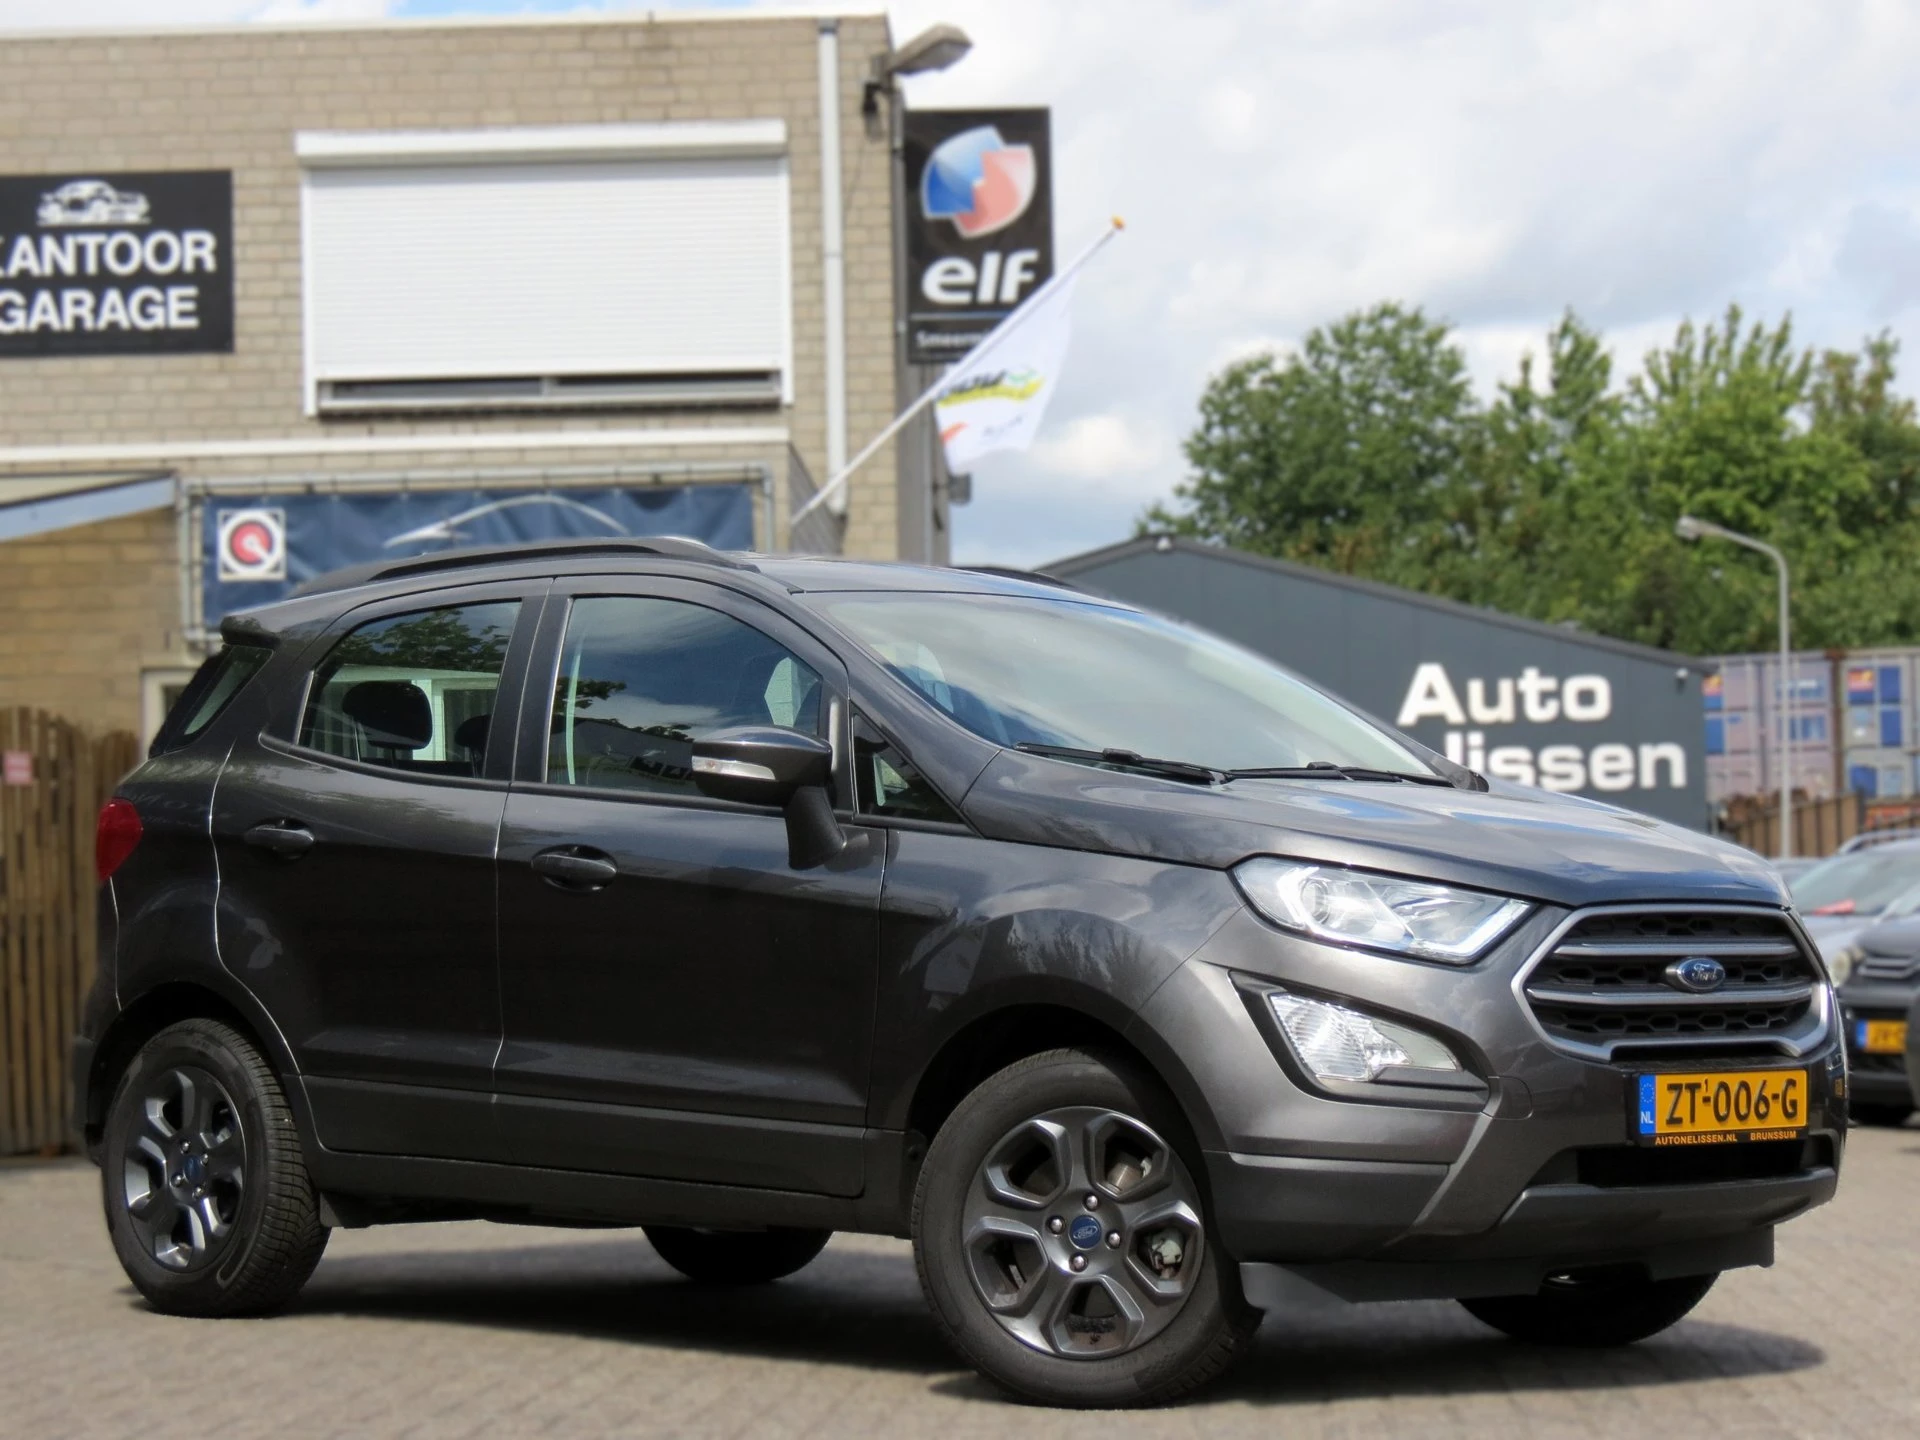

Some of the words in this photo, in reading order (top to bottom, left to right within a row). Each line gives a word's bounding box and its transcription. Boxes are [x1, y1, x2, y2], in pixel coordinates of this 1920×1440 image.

[0, 230, 216, 277] ANTOOR
[922, 250, 1040, 304] elf
[0, 286, 199, 333] GARAGE
[1397, 662, 1612, 726] Auto
[1641, 1111, 1654, 1124] NL
[1655, 1132, 1738, 1145] AUTONELISSEN.NL
[1750, 1130, 1797, 1141] BRUNSSUM
